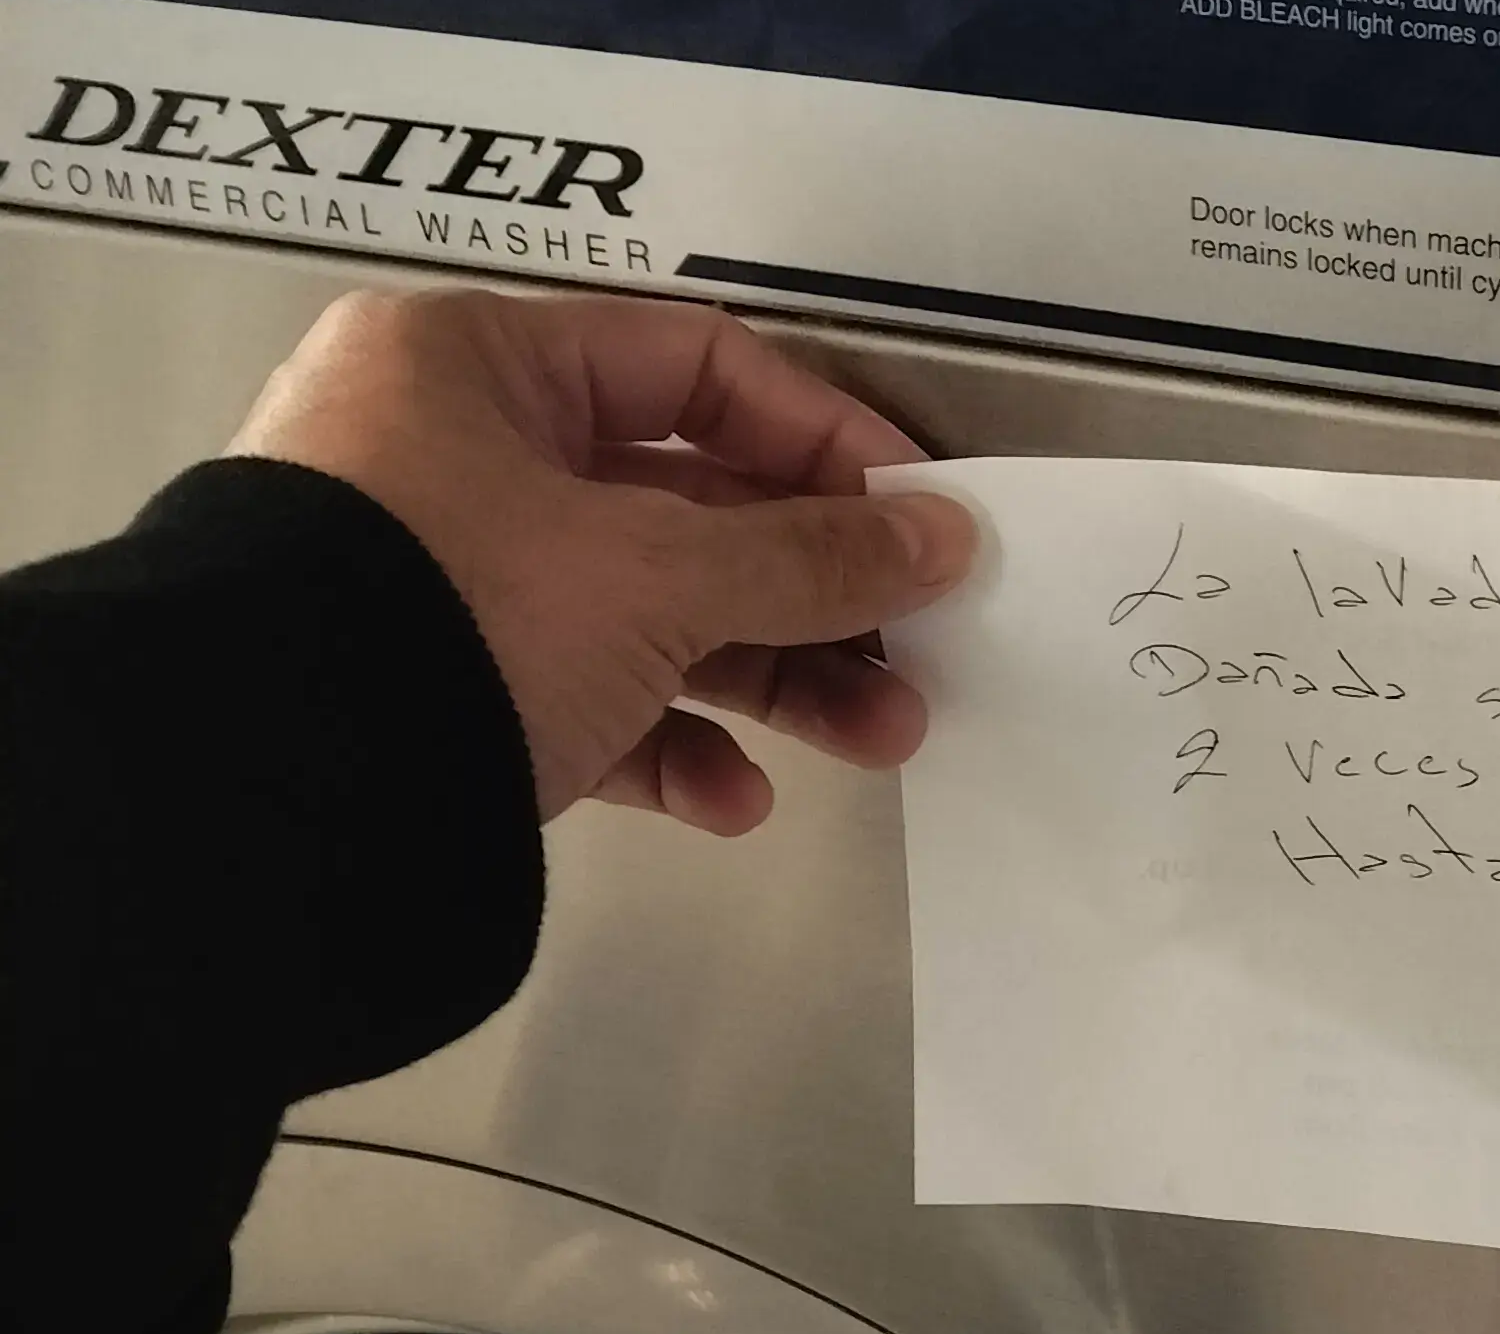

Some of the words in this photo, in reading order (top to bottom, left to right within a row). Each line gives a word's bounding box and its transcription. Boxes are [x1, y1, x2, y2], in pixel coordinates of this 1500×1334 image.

[1347, 9, 1393, 40] light
[1400, 16, 1476, 46] comes
[26, 75, 645, 218] DEXTER
[30, 160, 382, 236] COMMERCIAL
[415, 209, 652, 273] WASHER
[1190, 196, 1256, 229] Door
[1264, 205, 1334, 239] locks
[1343, 217, 1417, 250] when
[1190, 237, 1299, 271] remains
[1307, 248, 1396, 284] locked
[1405, 263, 1463, 292] until
[1108, 522, 1230, 626] La
[1129, 643, 1406, 698] Dañada
[1173, 727, 1228, 795] 2
